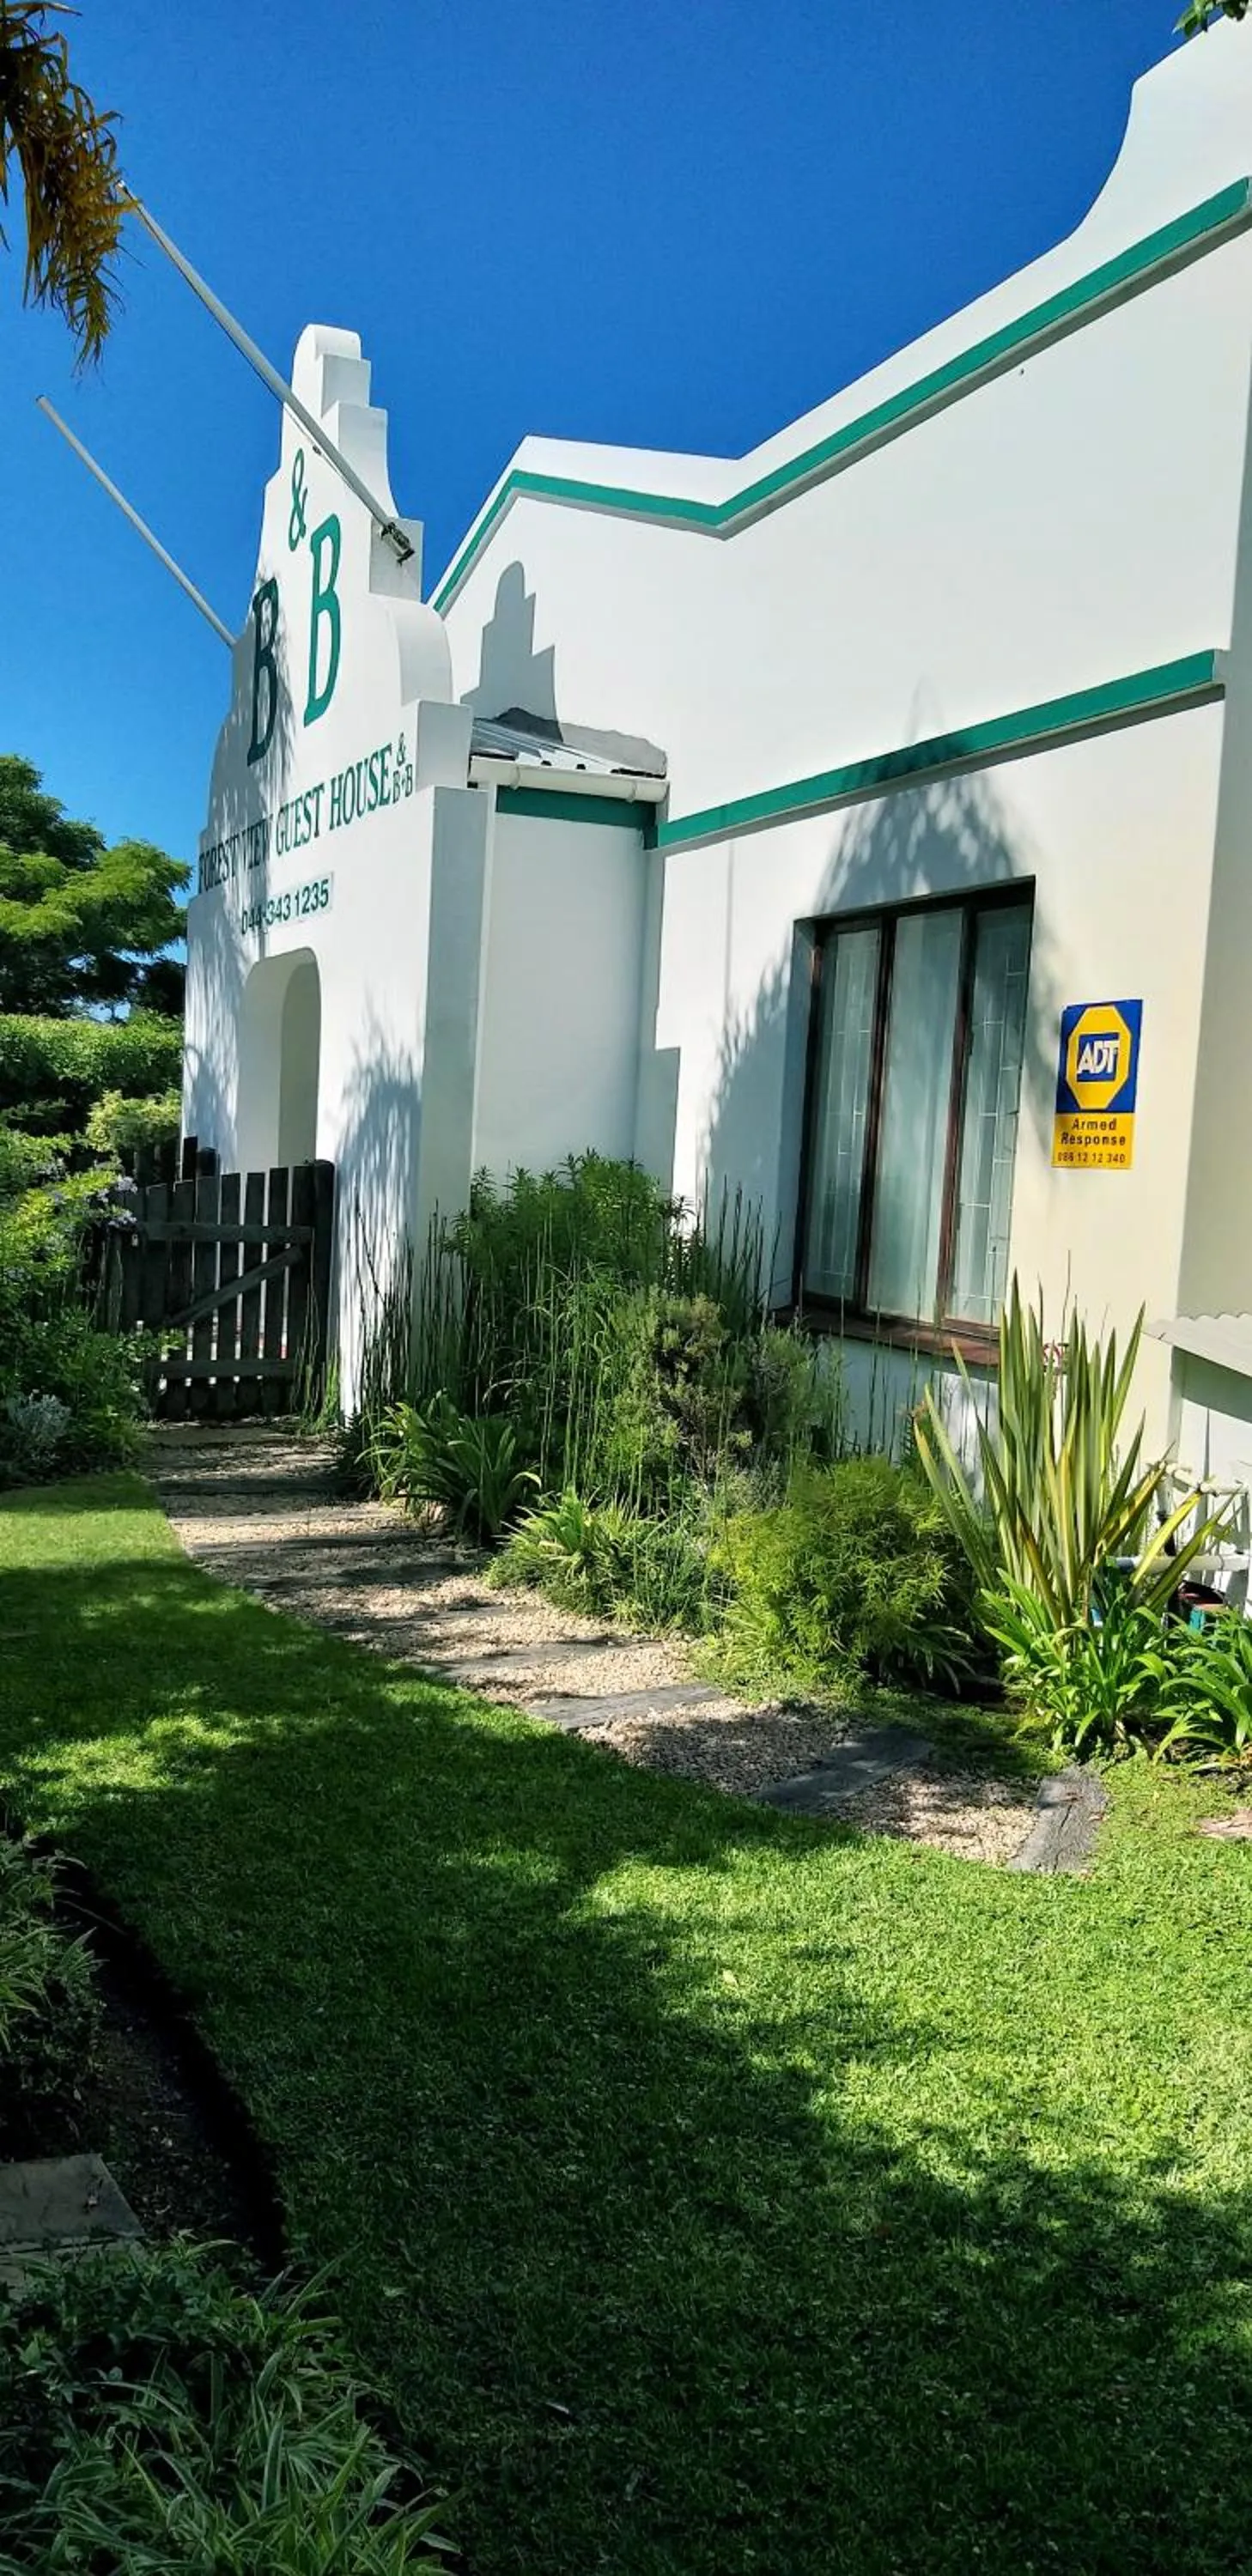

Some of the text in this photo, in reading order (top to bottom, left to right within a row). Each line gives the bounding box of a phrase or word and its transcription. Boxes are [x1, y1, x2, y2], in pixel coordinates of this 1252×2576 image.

[288, 447, 308, 552] &
[246, 513, 342, 767] B B
[275, 782, 325, 857] GUEST
[328, 742, 392, 831] HOUSE
[295, 878, 330, 916] 1235
[1077, 1039, 1120, 1074] ADT
[1061, 1131, 1127, 1148] Response
[1072, 1117, 1117, 1131] Armed
